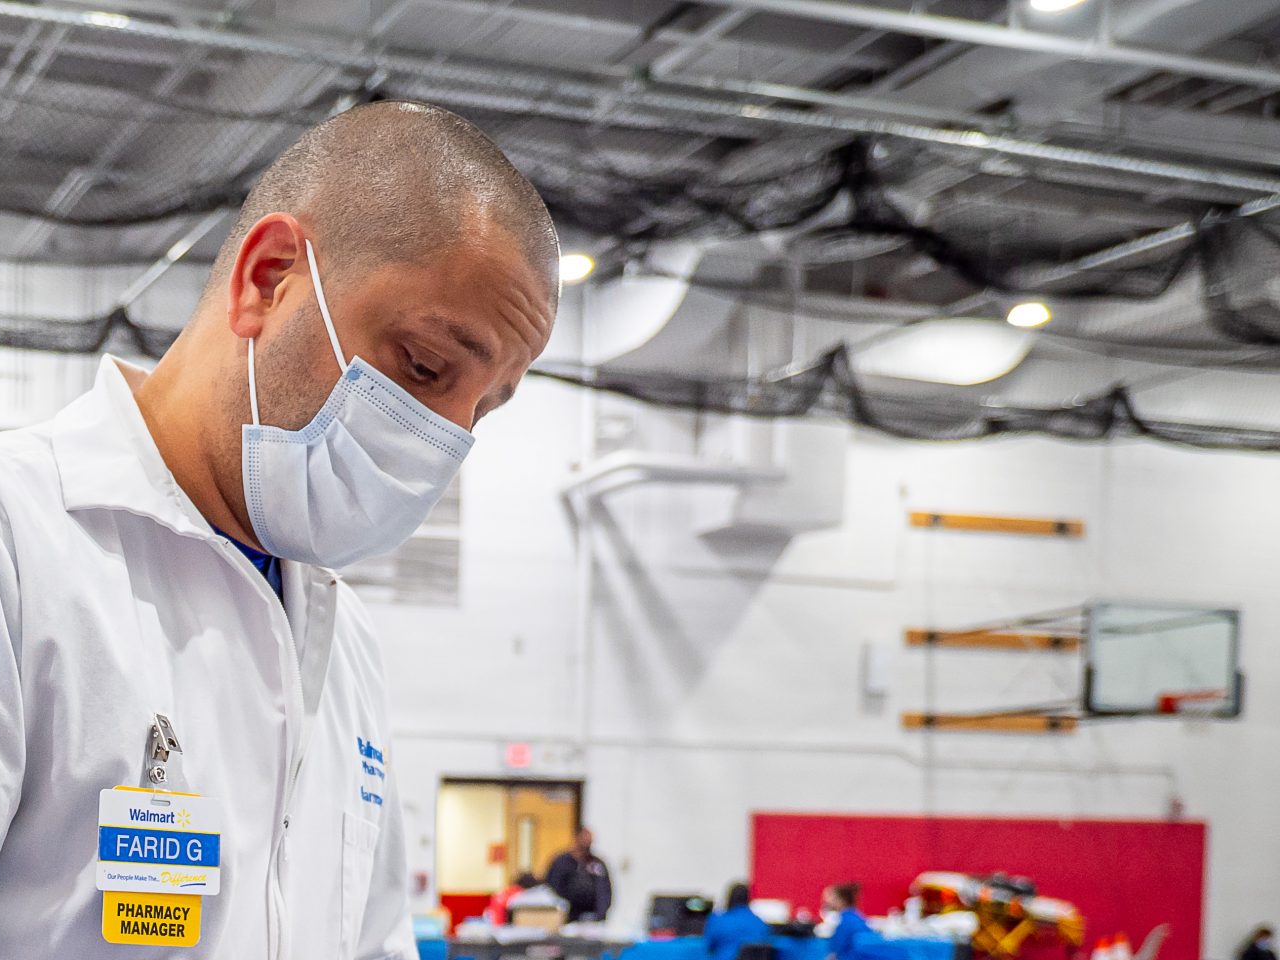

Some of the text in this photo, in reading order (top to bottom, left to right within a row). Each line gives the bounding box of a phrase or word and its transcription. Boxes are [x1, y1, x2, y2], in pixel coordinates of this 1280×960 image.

[129, 808, 175, 824] Walmart
[116, 834, 202, 862] FARID G
[117, 873, 133, 882] People
[161, 871, 207, 887] Difference
[117, 902, 190, 921] PHARMACY
[120, 920, 185, 938] MANAGER
